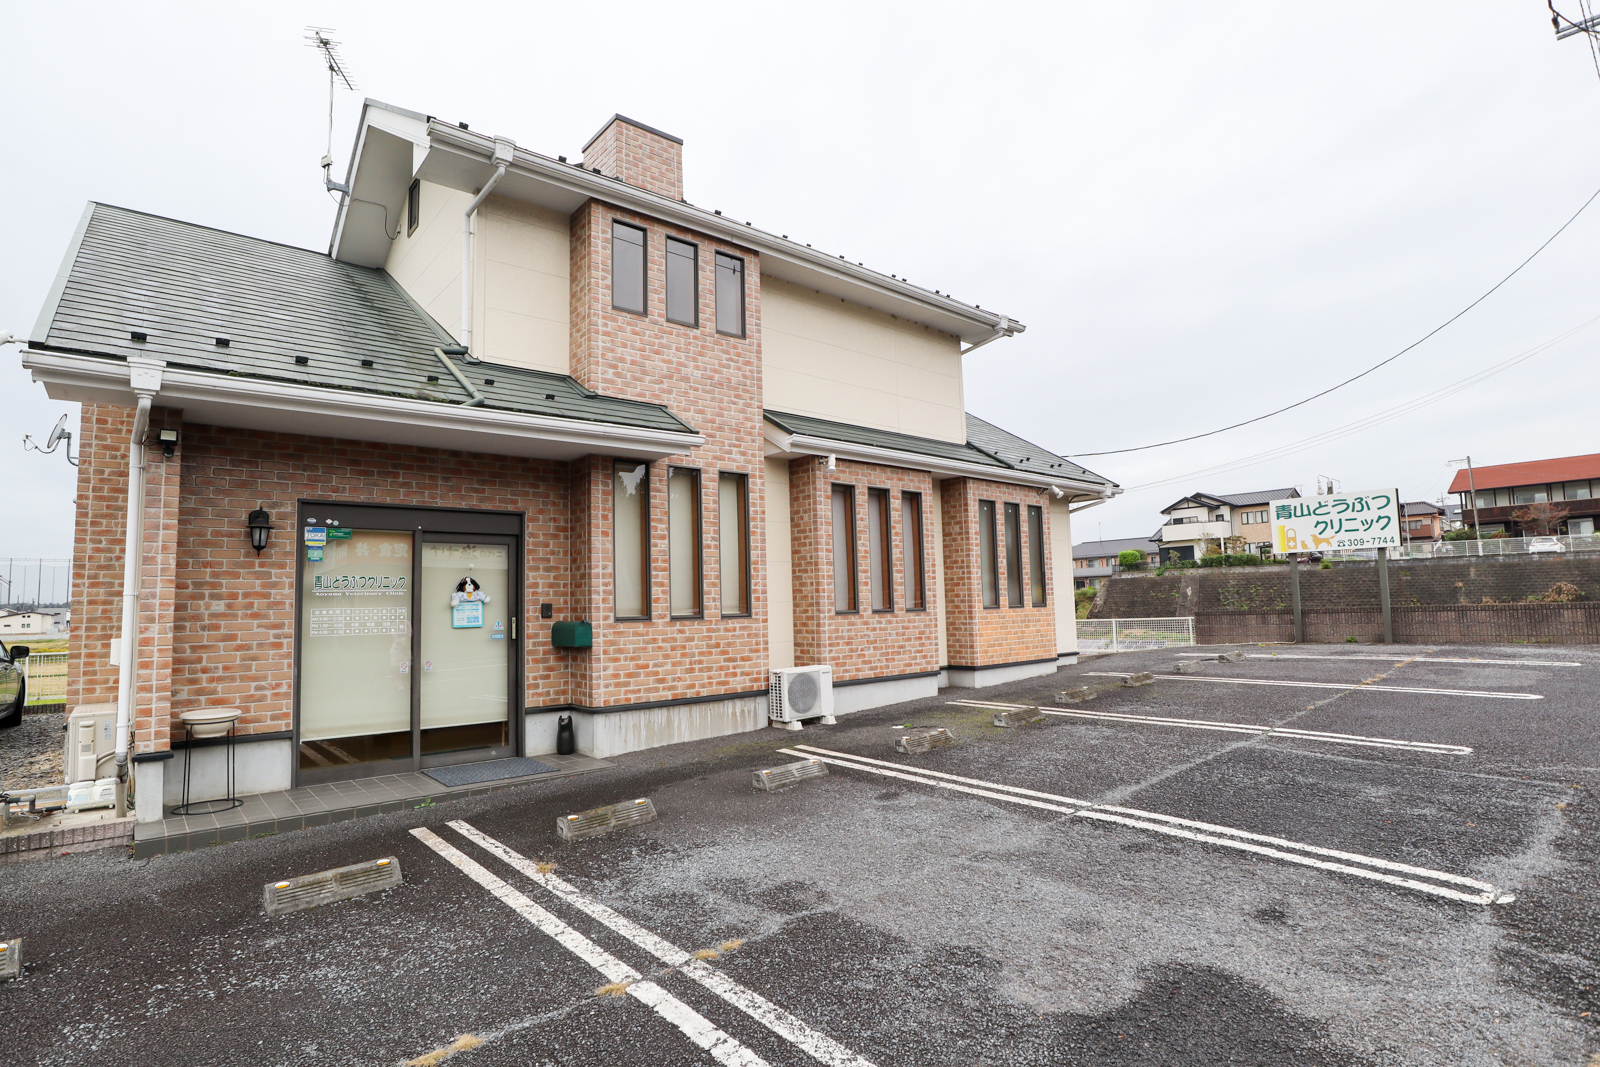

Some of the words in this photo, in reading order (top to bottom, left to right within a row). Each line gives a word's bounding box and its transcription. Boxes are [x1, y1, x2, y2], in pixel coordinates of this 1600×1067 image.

[1275, 495, 1391, 520] 青山どうぶつ
[1313, 515, 1391, 535] クリニック
[1347, 536, 1395, 547] 309-7744
